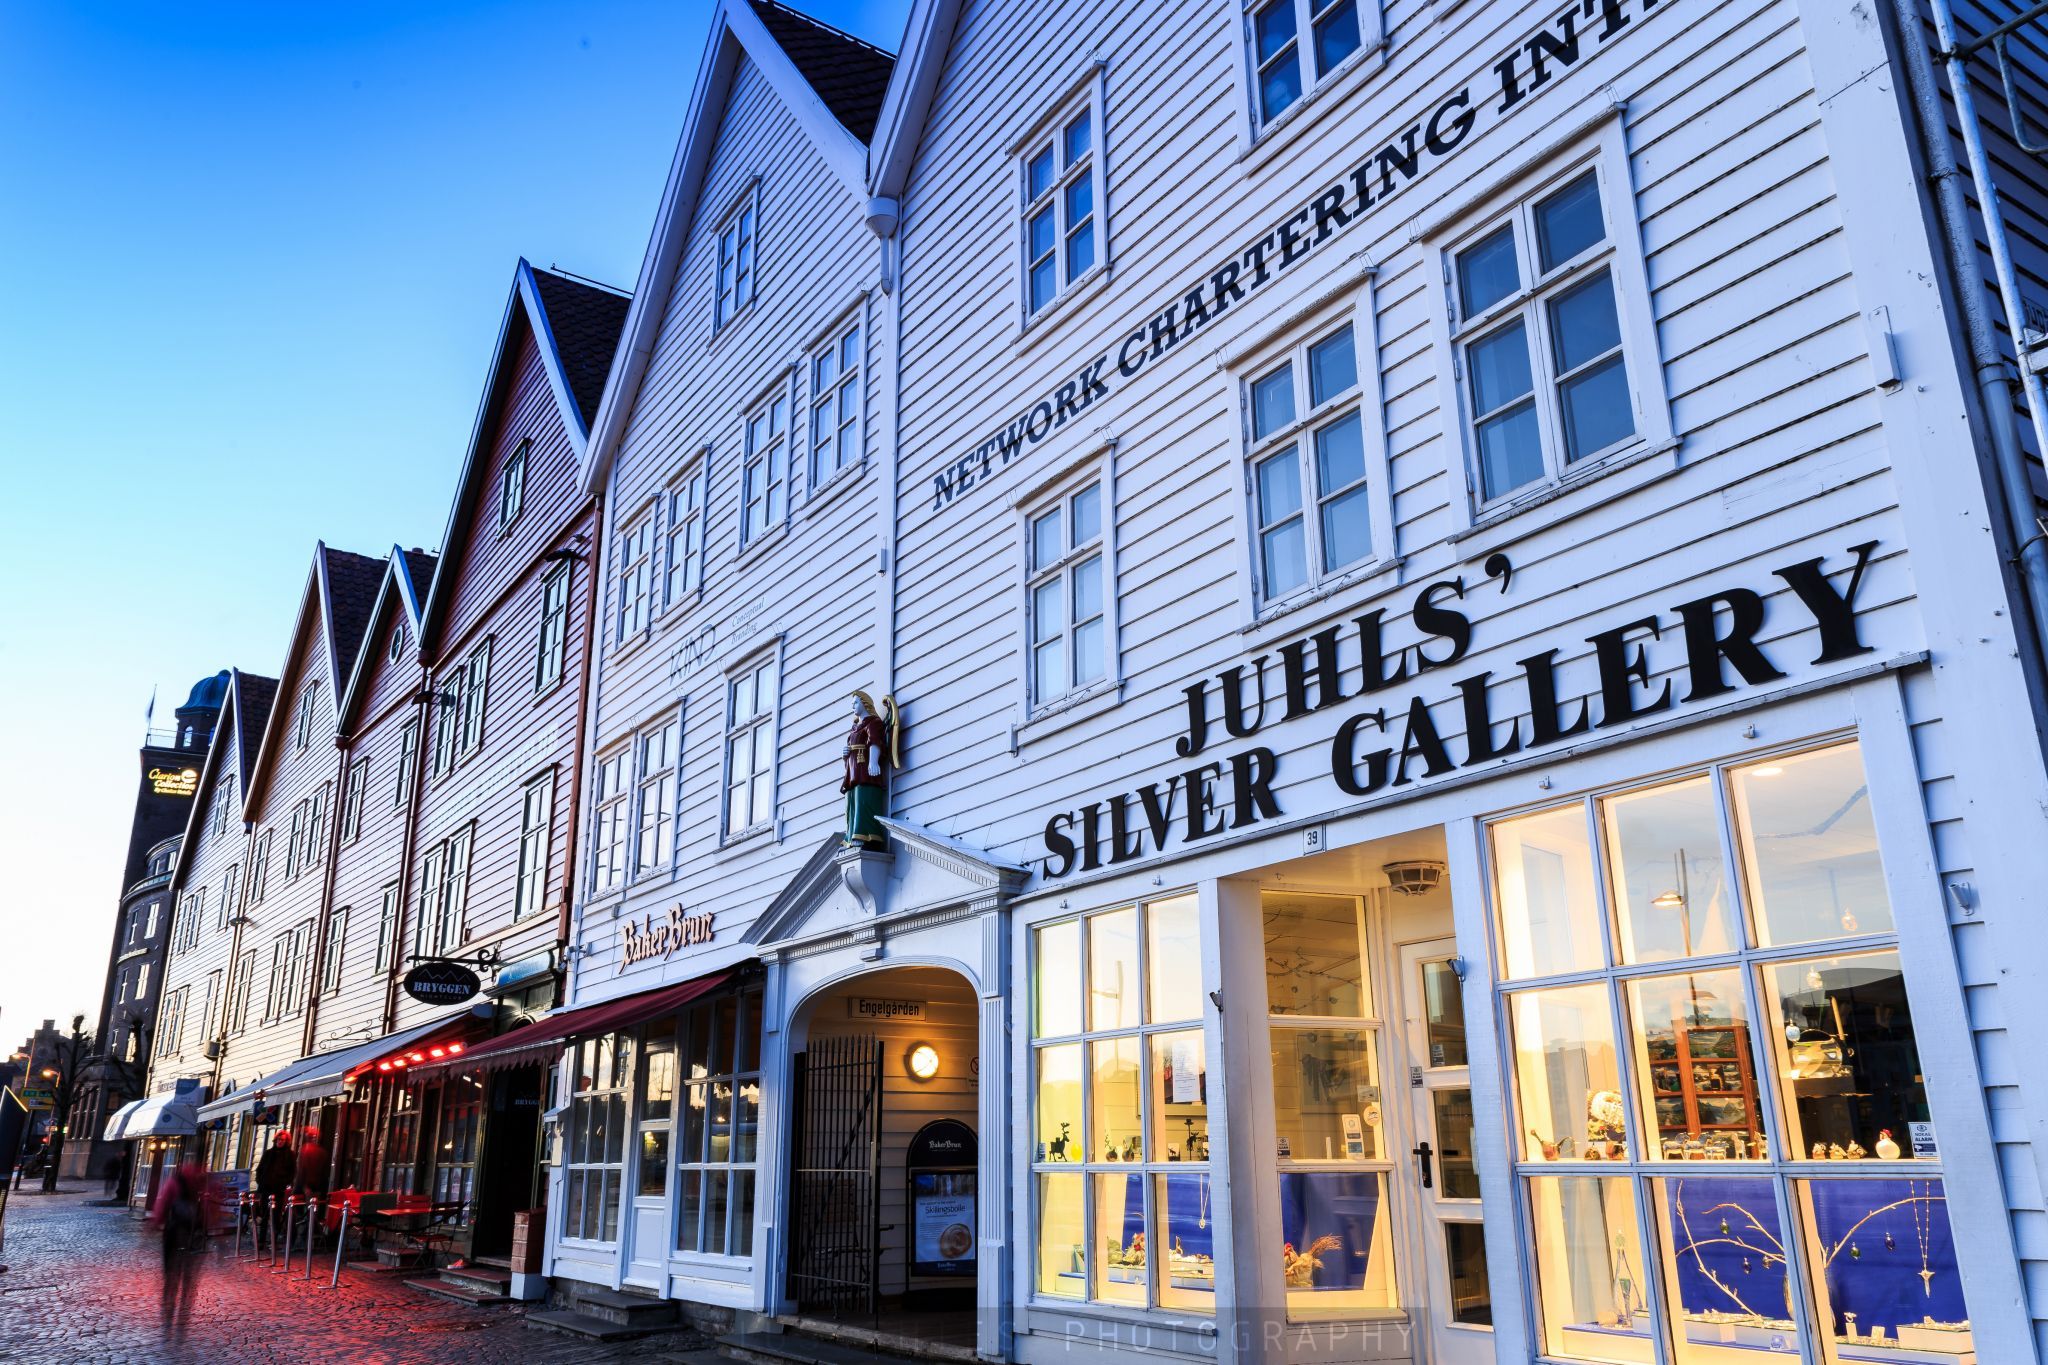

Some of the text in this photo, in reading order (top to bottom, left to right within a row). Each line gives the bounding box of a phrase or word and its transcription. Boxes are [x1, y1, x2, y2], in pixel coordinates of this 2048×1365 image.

[932, 0, 1659, 511] NETWORK CHARTERING INT
[669, 623, 716, 686] KIND
[1043, 539, 1880, 880] SILVER GALLERY
[148, 769, 181, 781] Clarion
[154, 779, 195, 790] Collection
[1307, 830, 1318, 846] 39
[413, 981, 471, 994] BRYGGEN
[859, 1000, 919, 1018] Engelgården
